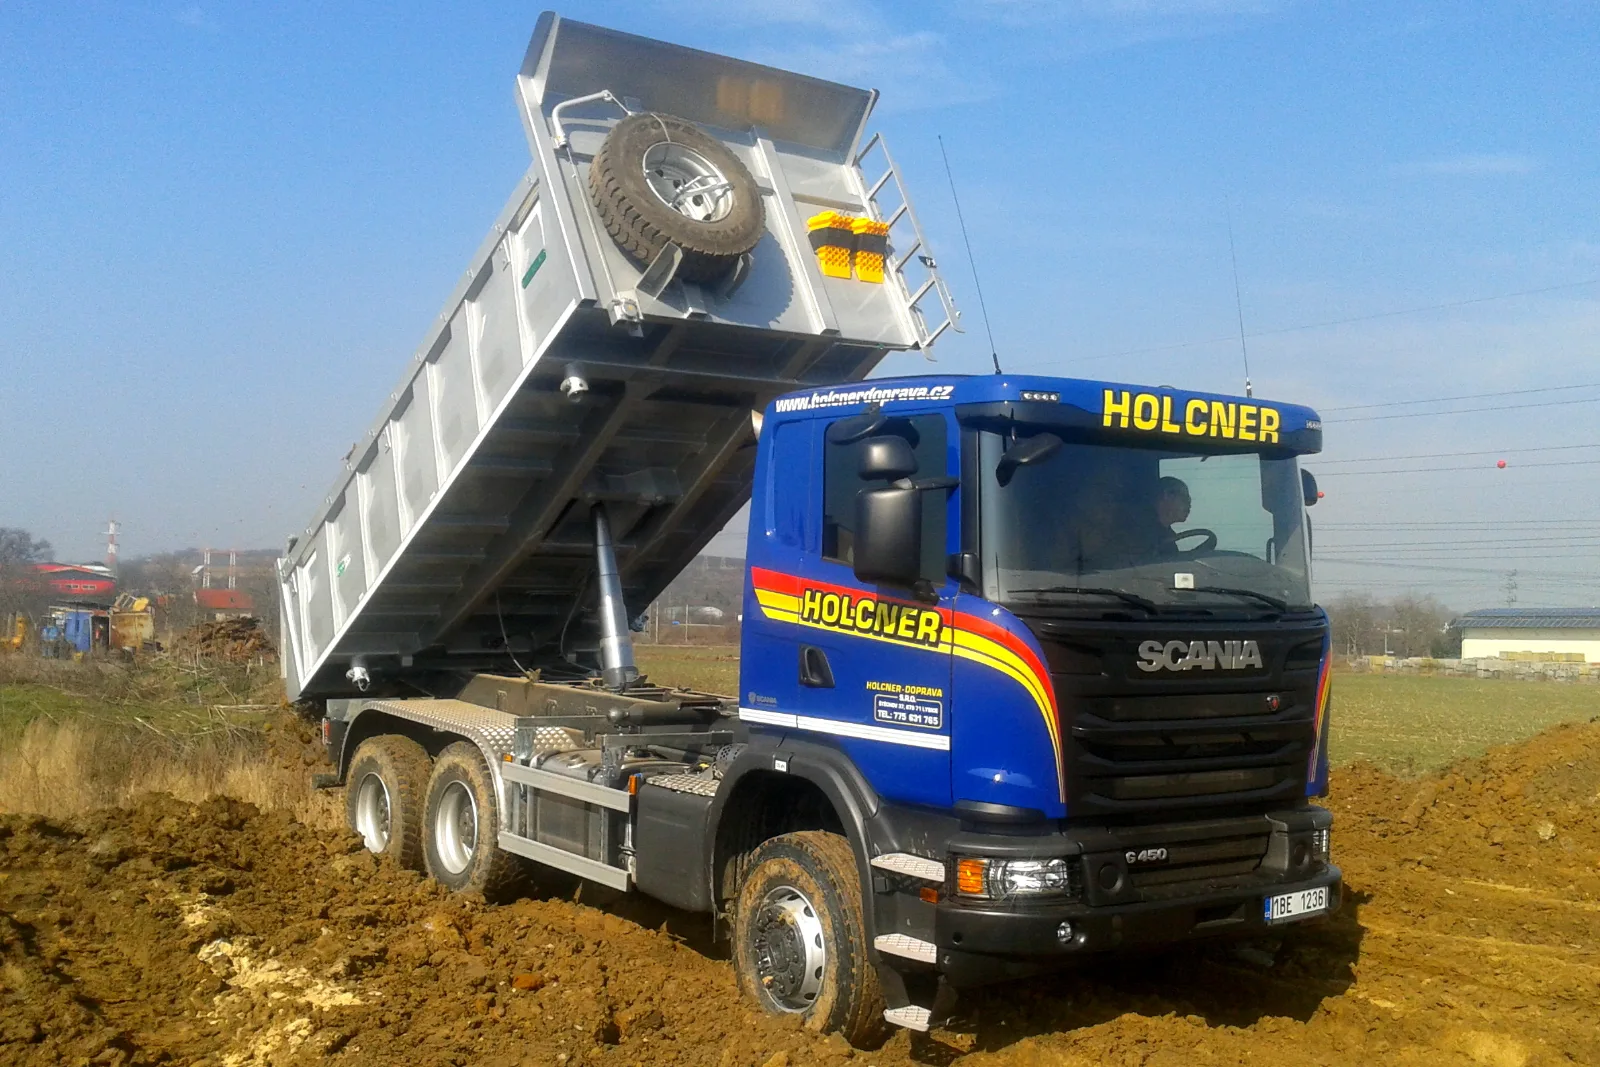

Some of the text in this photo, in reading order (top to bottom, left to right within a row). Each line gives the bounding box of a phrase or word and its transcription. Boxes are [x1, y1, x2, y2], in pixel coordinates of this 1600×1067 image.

[775, 386, 954, 413] www.holcnerdoprava.cz
[1103, 389, 1280, 443] HOLCNER
[802, 589, 941, 645] HOLCNER
[1136, 640, 1263, 672] SCANIA
[893, 711, 907, 720] 775
[908, 713, 922, 722] 631
[923, 716, 939, 725] 765
[1125, 848, 1168, 864] G 450
[1273, 889, 1324, 916] 1BE 1236
